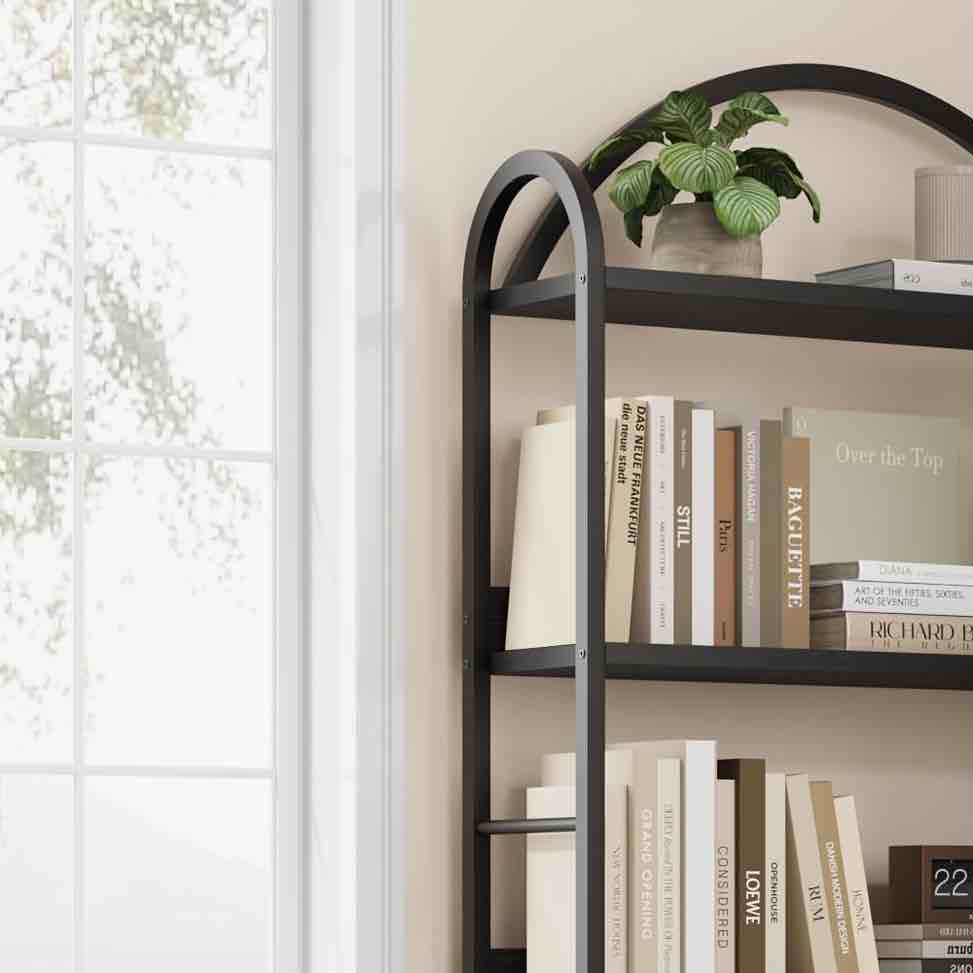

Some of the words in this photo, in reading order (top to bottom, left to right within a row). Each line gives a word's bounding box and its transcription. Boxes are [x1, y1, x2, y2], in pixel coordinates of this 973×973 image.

[621, 403, 633, 420] die
[636, 405, 648, 432] DAS
[616, 455, 628, 485] stadt
[632, 436, 645, 469] NEUE
[836, 441, 875, 465] Over
[880, 443, 905, 466] the
[911, 446, 945, 477] Top
[627, 472, 642, 545] FRANKFURT
[677, 505, 691, 549] STILL
[719, 520, 731, 553] Paris
[787, 486, 803, 609] BAGUETTE
[870, 620, 955, 641] RICHARD
[639, 808, 654, 864] GRAND
[716, 845, 730, 949] CONSIDERED
[745, 870, 761, 925] LOEWE
[769, 862, 779, 924] OPENHOUSE
[934, 868, 969, 896] 22
[639, 869, 654, 940] OPENING
